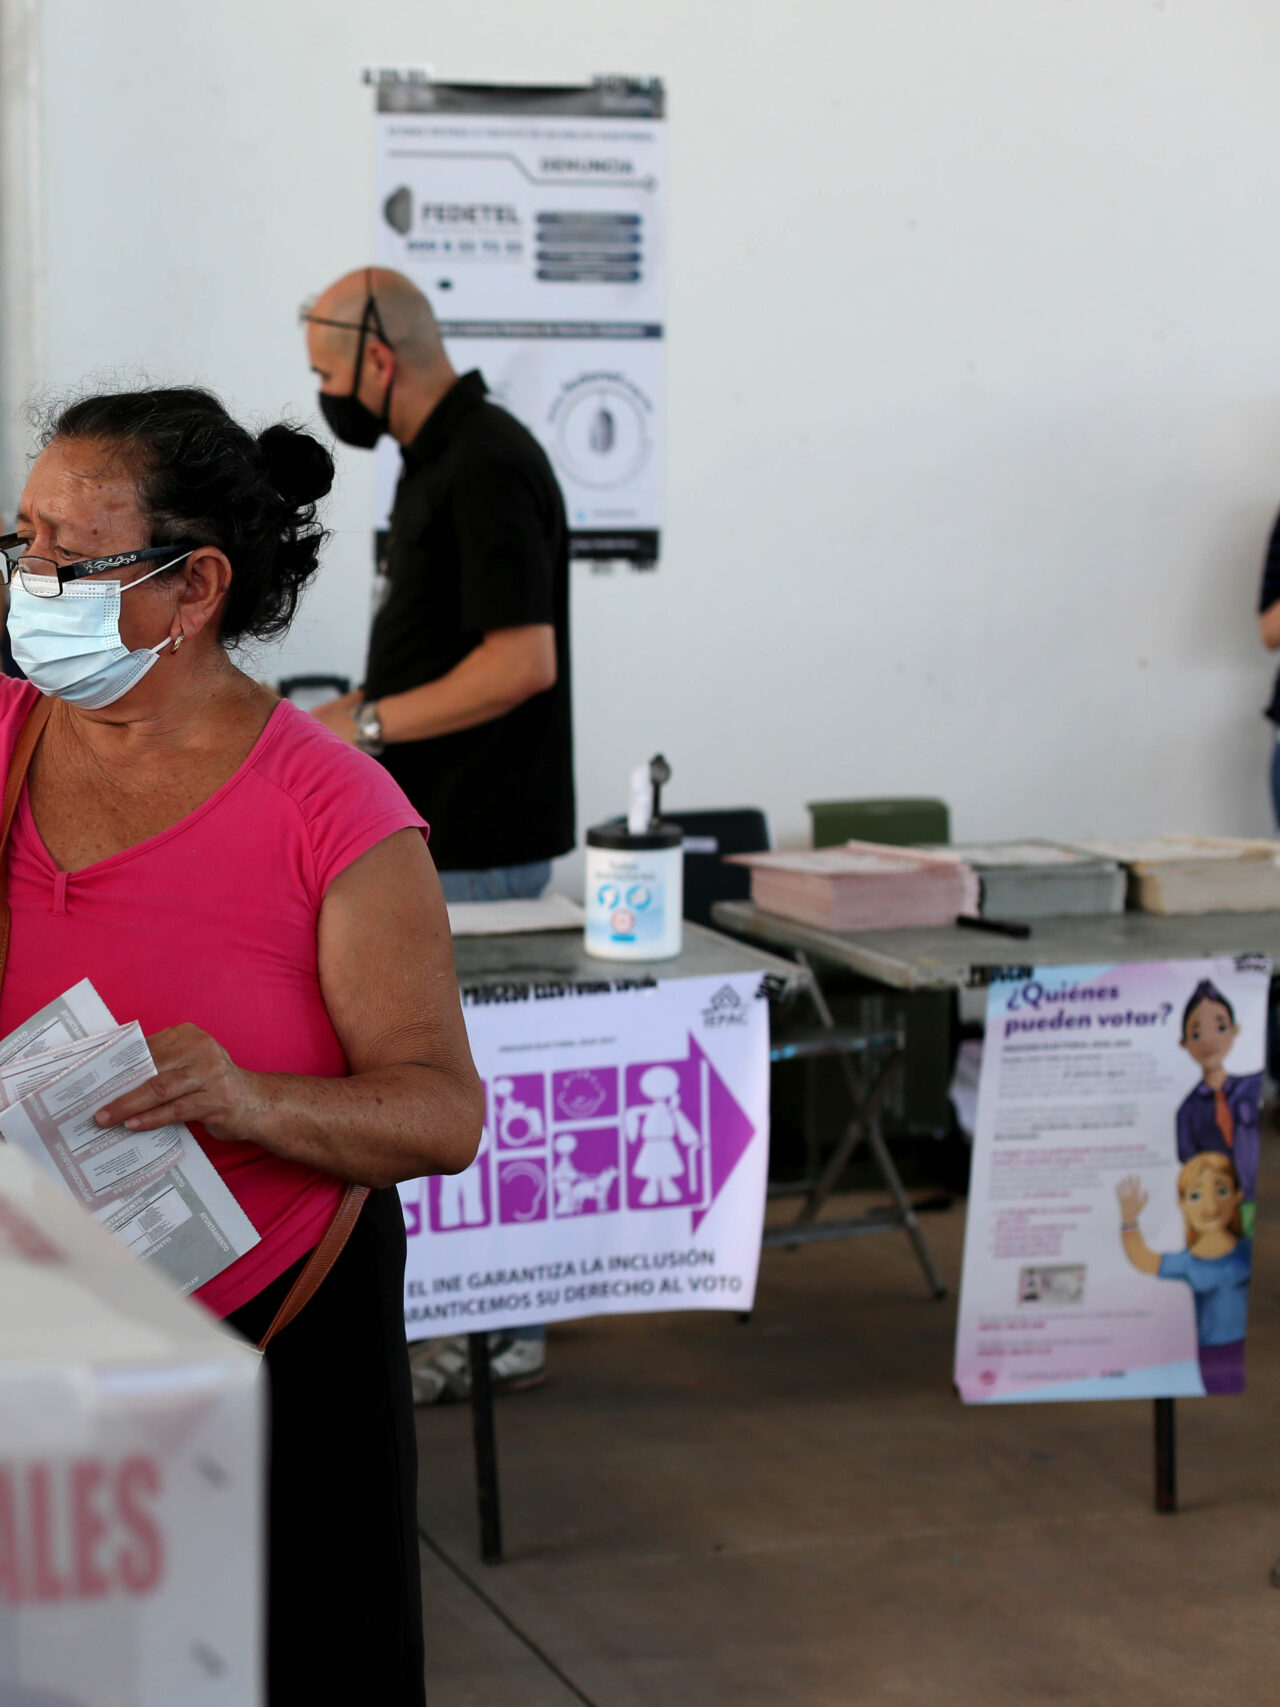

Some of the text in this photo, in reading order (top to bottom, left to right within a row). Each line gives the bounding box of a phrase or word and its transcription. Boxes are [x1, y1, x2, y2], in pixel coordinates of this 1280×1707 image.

[422, 203, 519, 224] FEDETEL
[1005, 1003, 1173, 1038] pueden votar?
[408, 1248, 715, 1298] EL INE GARANTIZA LA INCLUSIÓN
[536, 1288, 560, 1308] SU
[563, 1278, 655, 1303] DERECHO
[658, 1276, 682, 1294] AL
[687, 1275, 742, 1294] VOTO
